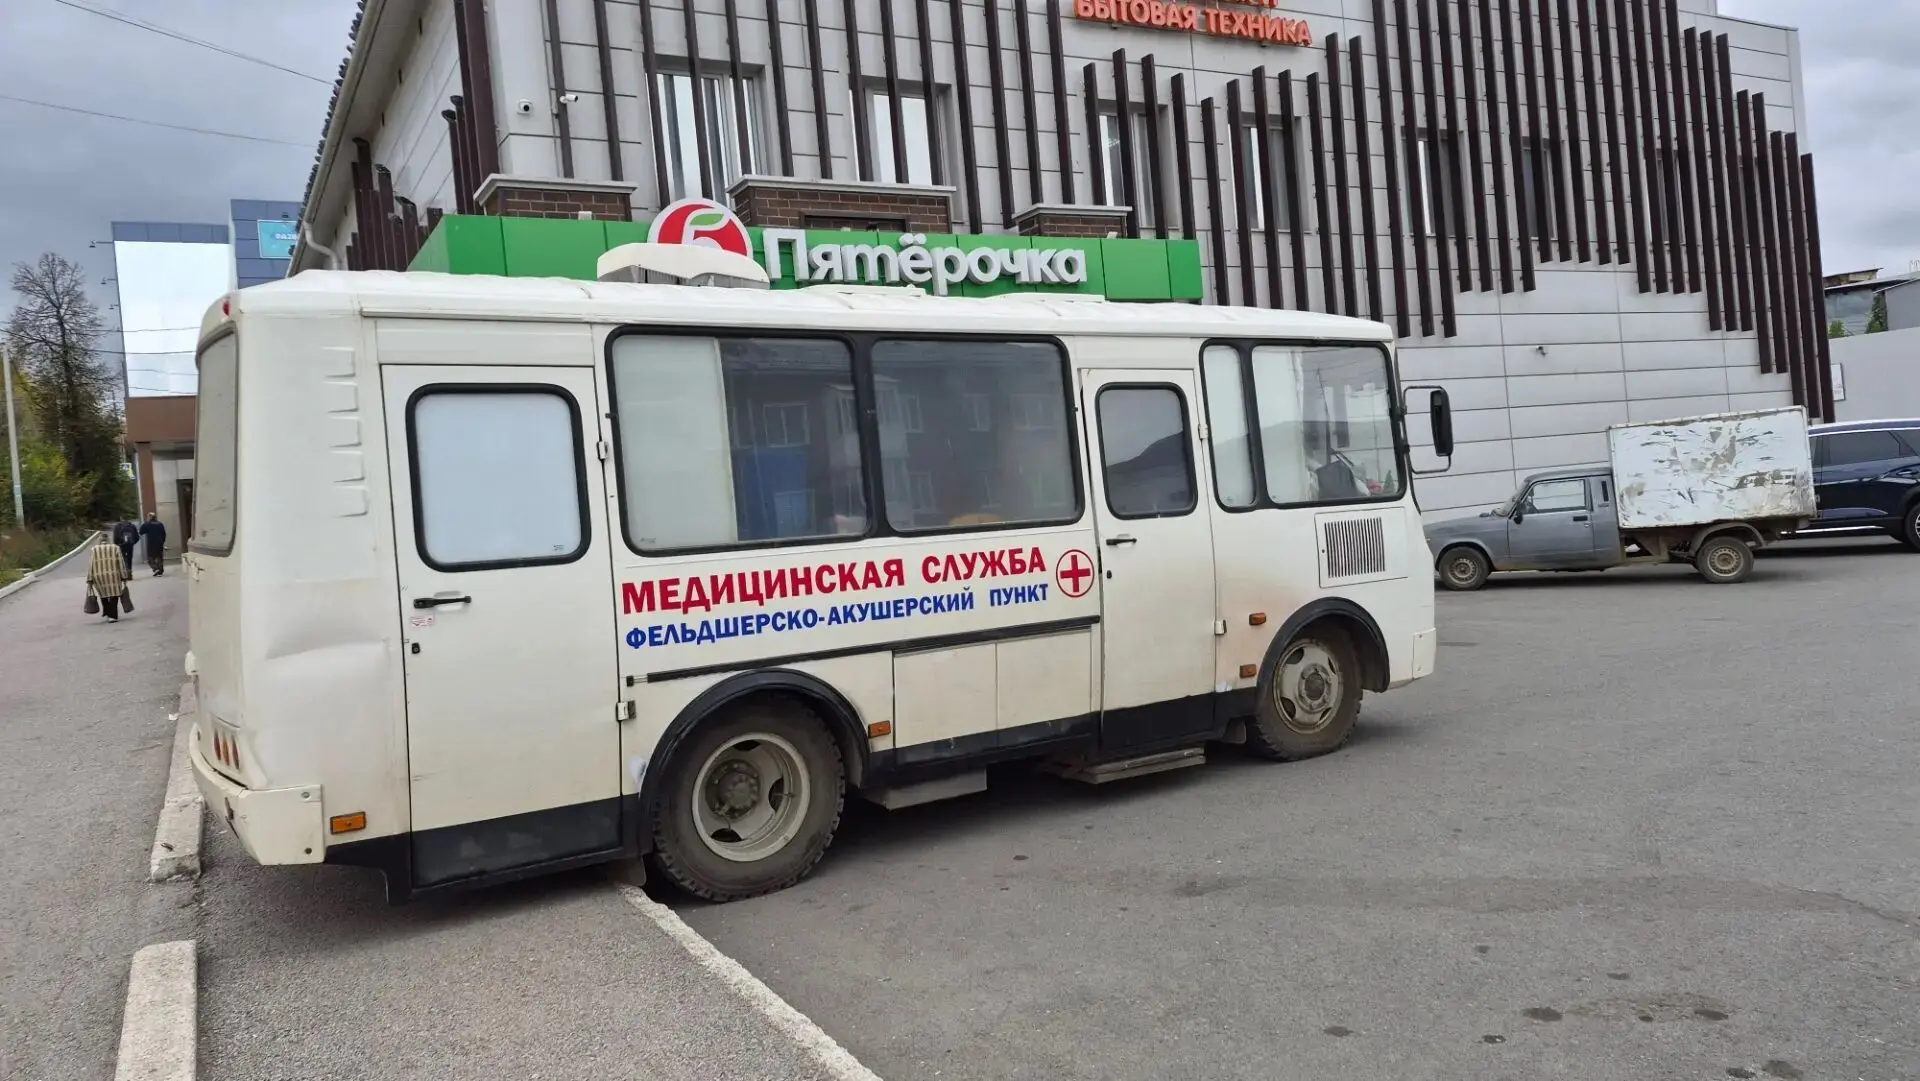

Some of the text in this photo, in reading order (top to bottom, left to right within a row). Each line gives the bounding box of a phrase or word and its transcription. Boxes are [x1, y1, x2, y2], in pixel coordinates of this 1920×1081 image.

[1074, 0, 1313, 46] БЫТОВАЯ ТЕХНИКА
[762, 228, 1088, 297] Пятёрочка
[622, 547, 1047, 614] МЕДИЦИНСКАЯ СЛУЖБА
[625, 583, 1049, 649] ФЕЛЬДШЕРСКО-АКУШЕРСКИЙ ПУНКТ
